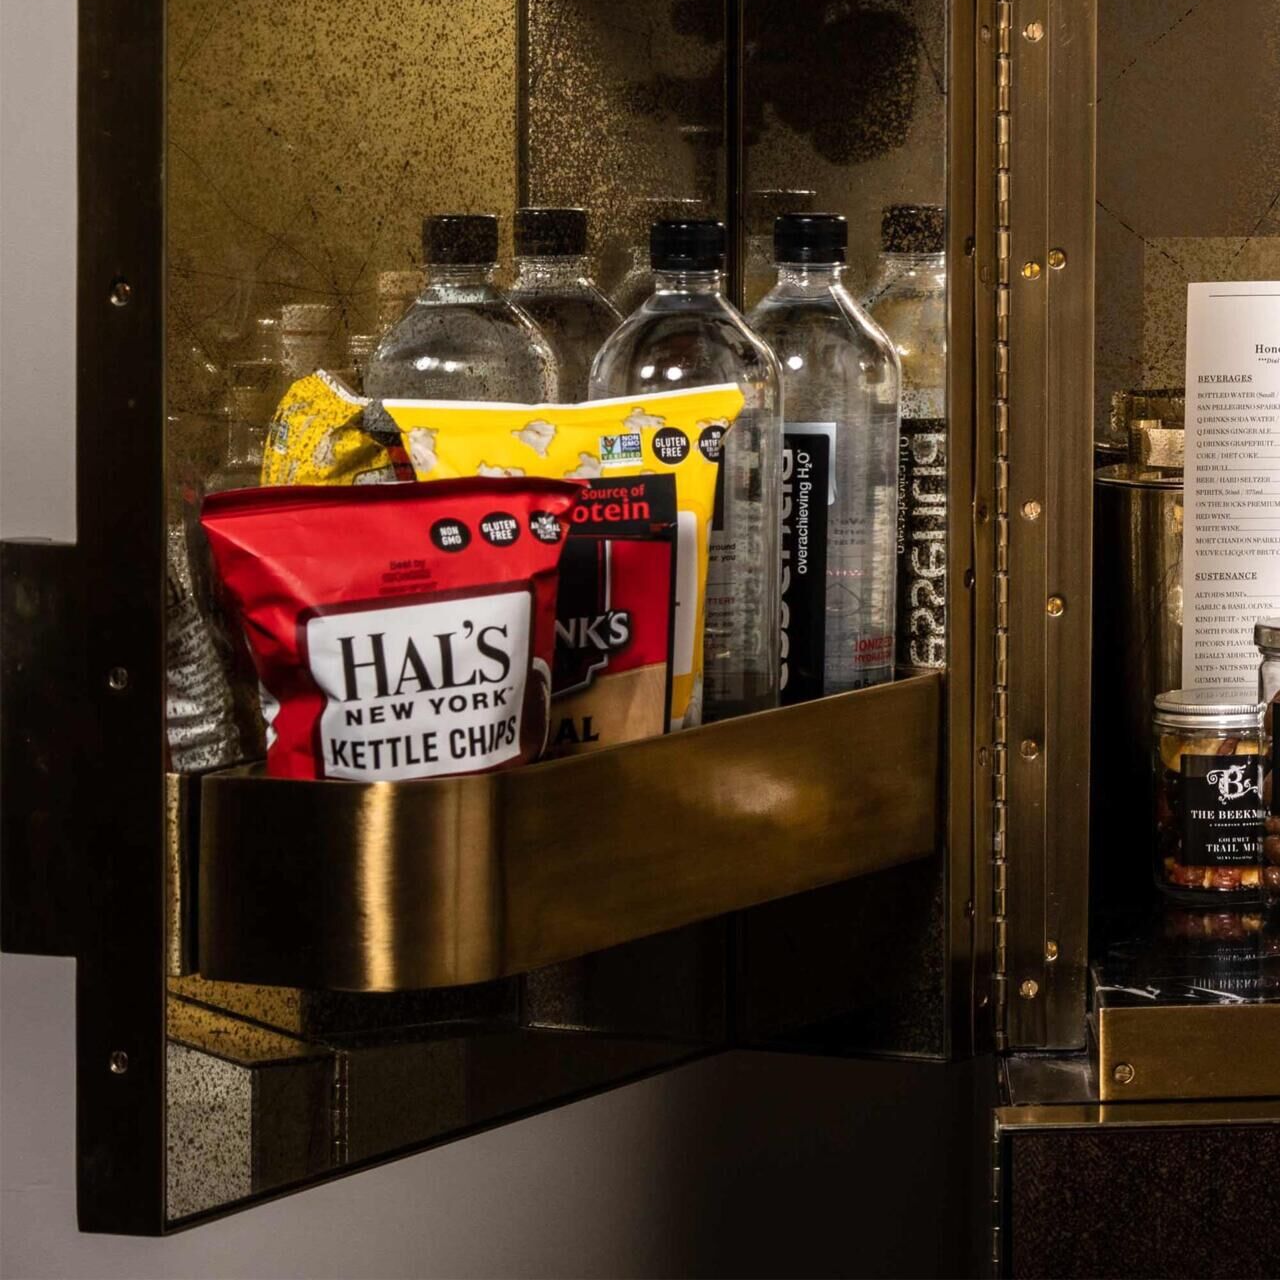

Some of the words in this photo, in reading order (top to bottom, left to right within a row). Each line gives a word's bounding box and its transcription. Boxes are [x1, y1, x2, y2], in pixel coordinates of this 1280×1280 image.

[1198, 375, 1252, 383] BEVERAGES
[655, 438, 686, 448] GLUTEN
[661, 448, 681, 457] FREE
[581, 488, 628, 500] Source
[631, 484, 646, 496] of
[572, 498, 650, 522] otein
[440, 526, 459, 536] NON
[482, 520, 516, 533] GLUTEN
[798, 483, 812, 574] overachieving
[441, 535, 462, 546] GMO
[490, 530, 513, 540] FREE
[1195, 572, 1258, 580] SUSTENANCE
[555, 612, 629, 649] NK'S
[855, 636, 892, 652] IONIZED
[338, 620, 511, 702] HAL'S
[346, 701, 415, 726] NEW
[429, 688, 508, 715] YORK
[554, 716, 599, 744] AL
[330, 732, 438, 770] KETTLE
[449, 716, 516, 760] CHIPS
[1191, 810, 1214, 819] THE
[1206, 844, 1238, 852] TRAIL
